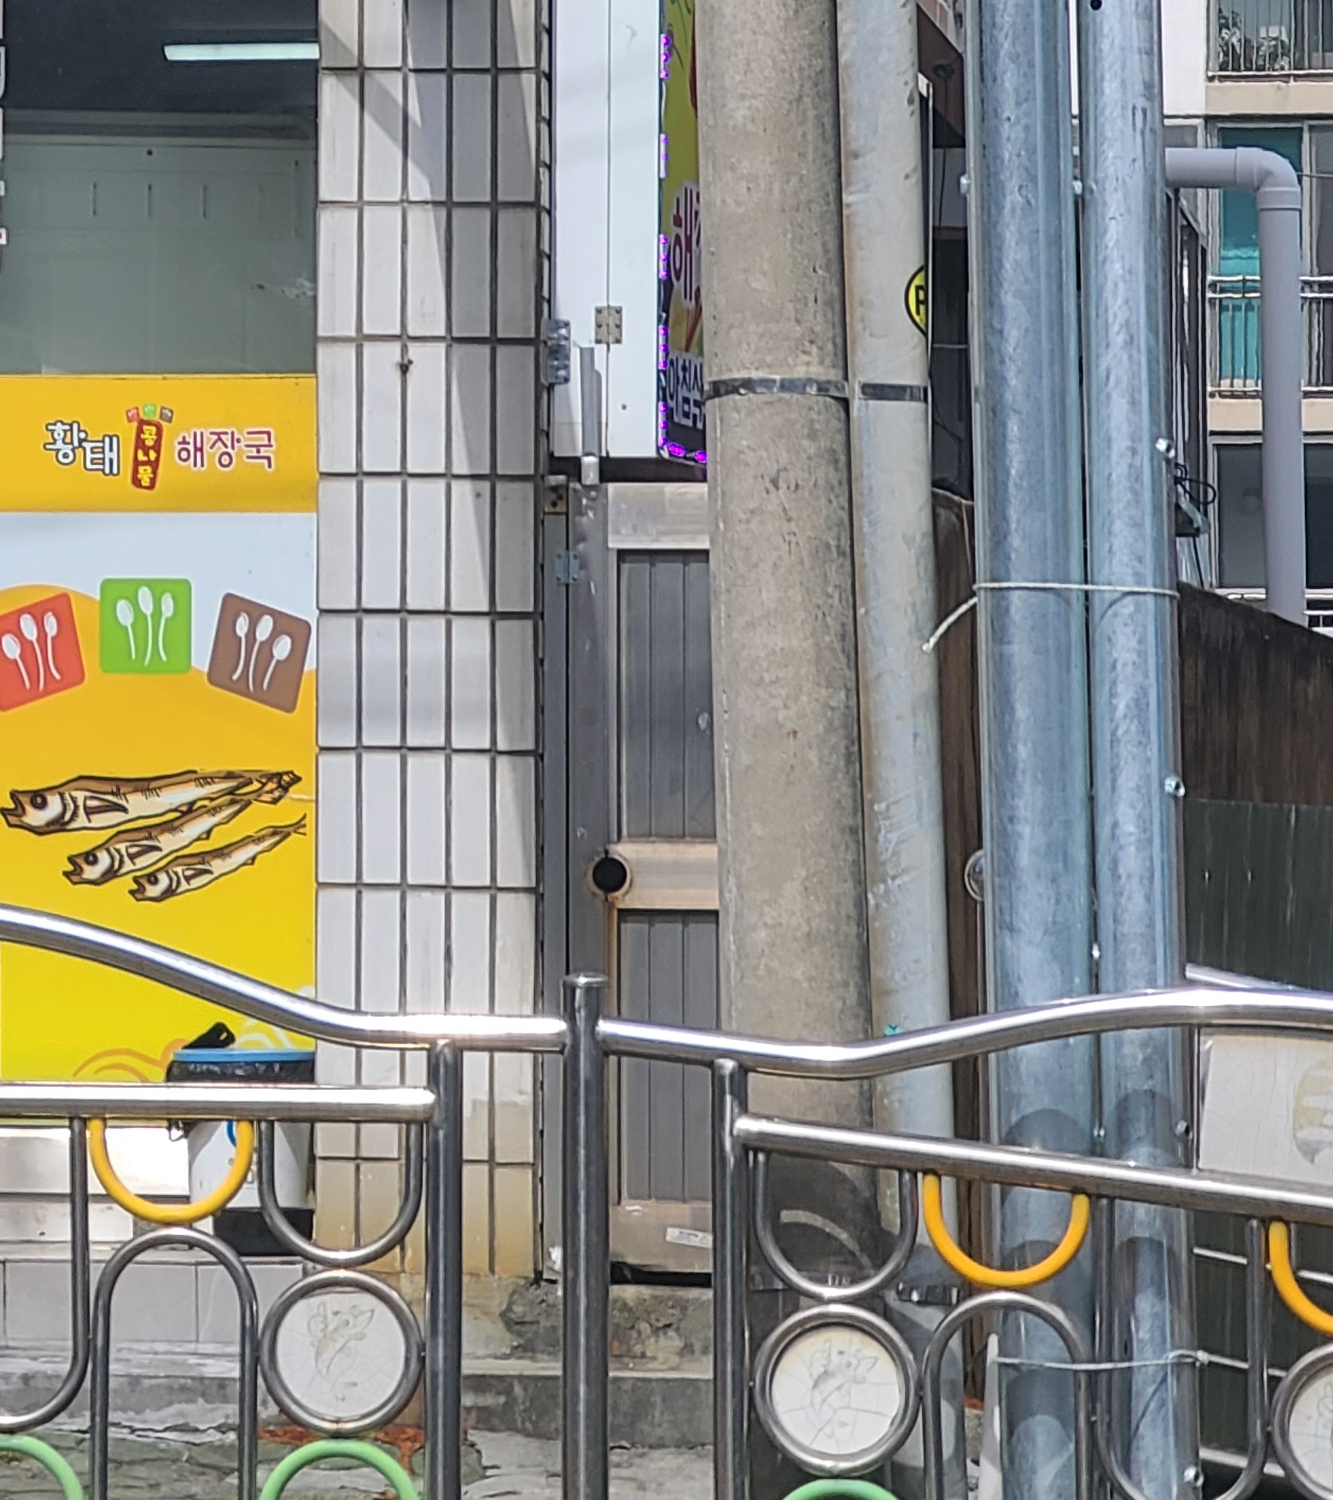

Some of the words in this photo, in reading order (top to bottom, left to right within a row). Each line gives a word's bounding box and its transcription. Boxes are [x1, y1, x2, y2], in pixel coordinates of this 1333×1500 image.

[43, 420, 120, 476] 황태
[136, 424, 158, 487] 콩나물
[175, 430, 275, 471] 해장국
